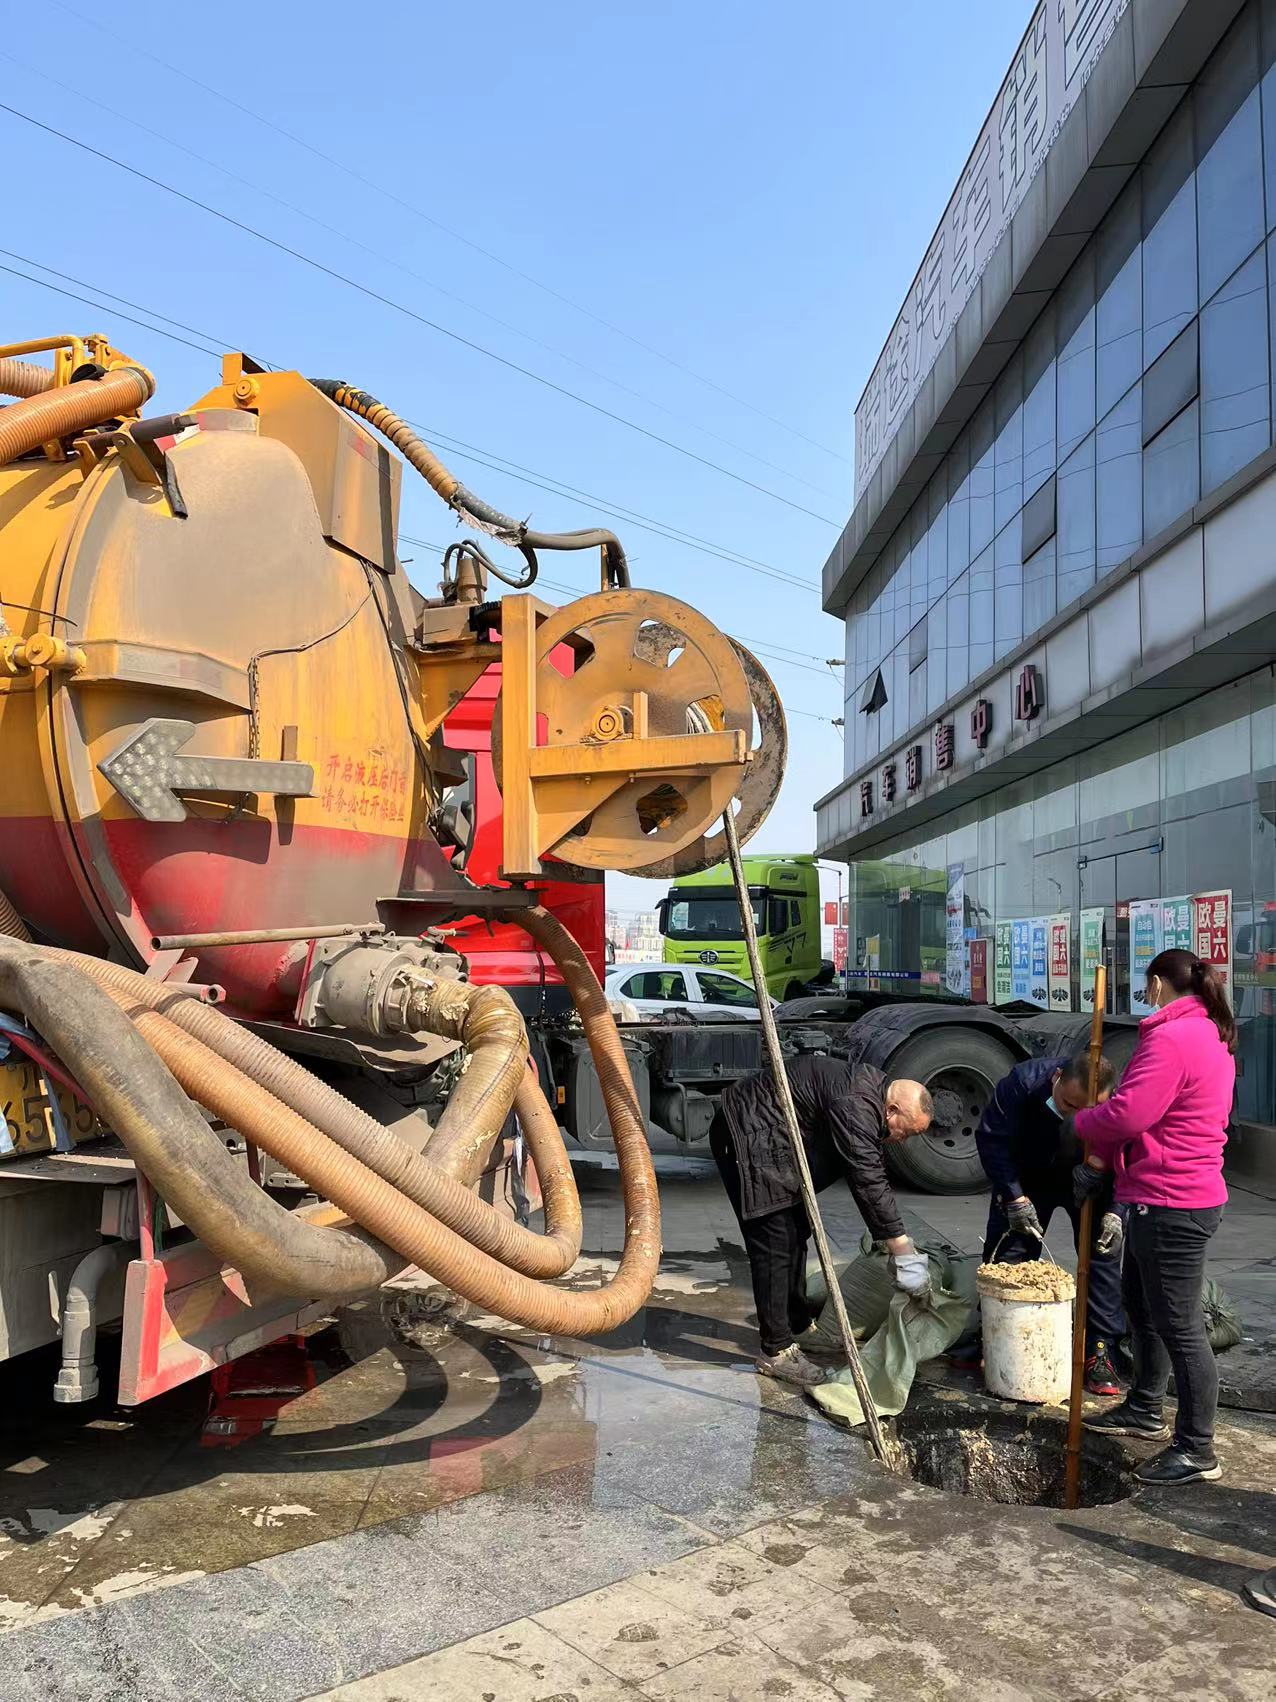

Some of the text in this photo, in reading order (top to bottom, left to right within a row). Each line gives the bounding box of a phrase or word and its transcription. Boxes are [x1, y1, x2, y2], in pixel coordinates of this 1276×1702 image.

[1164, 905, 1190, 931] 欧曼
[1199, 901, 1226, 928] 欧曼
[1199, 930, 1226, 959] 国六
